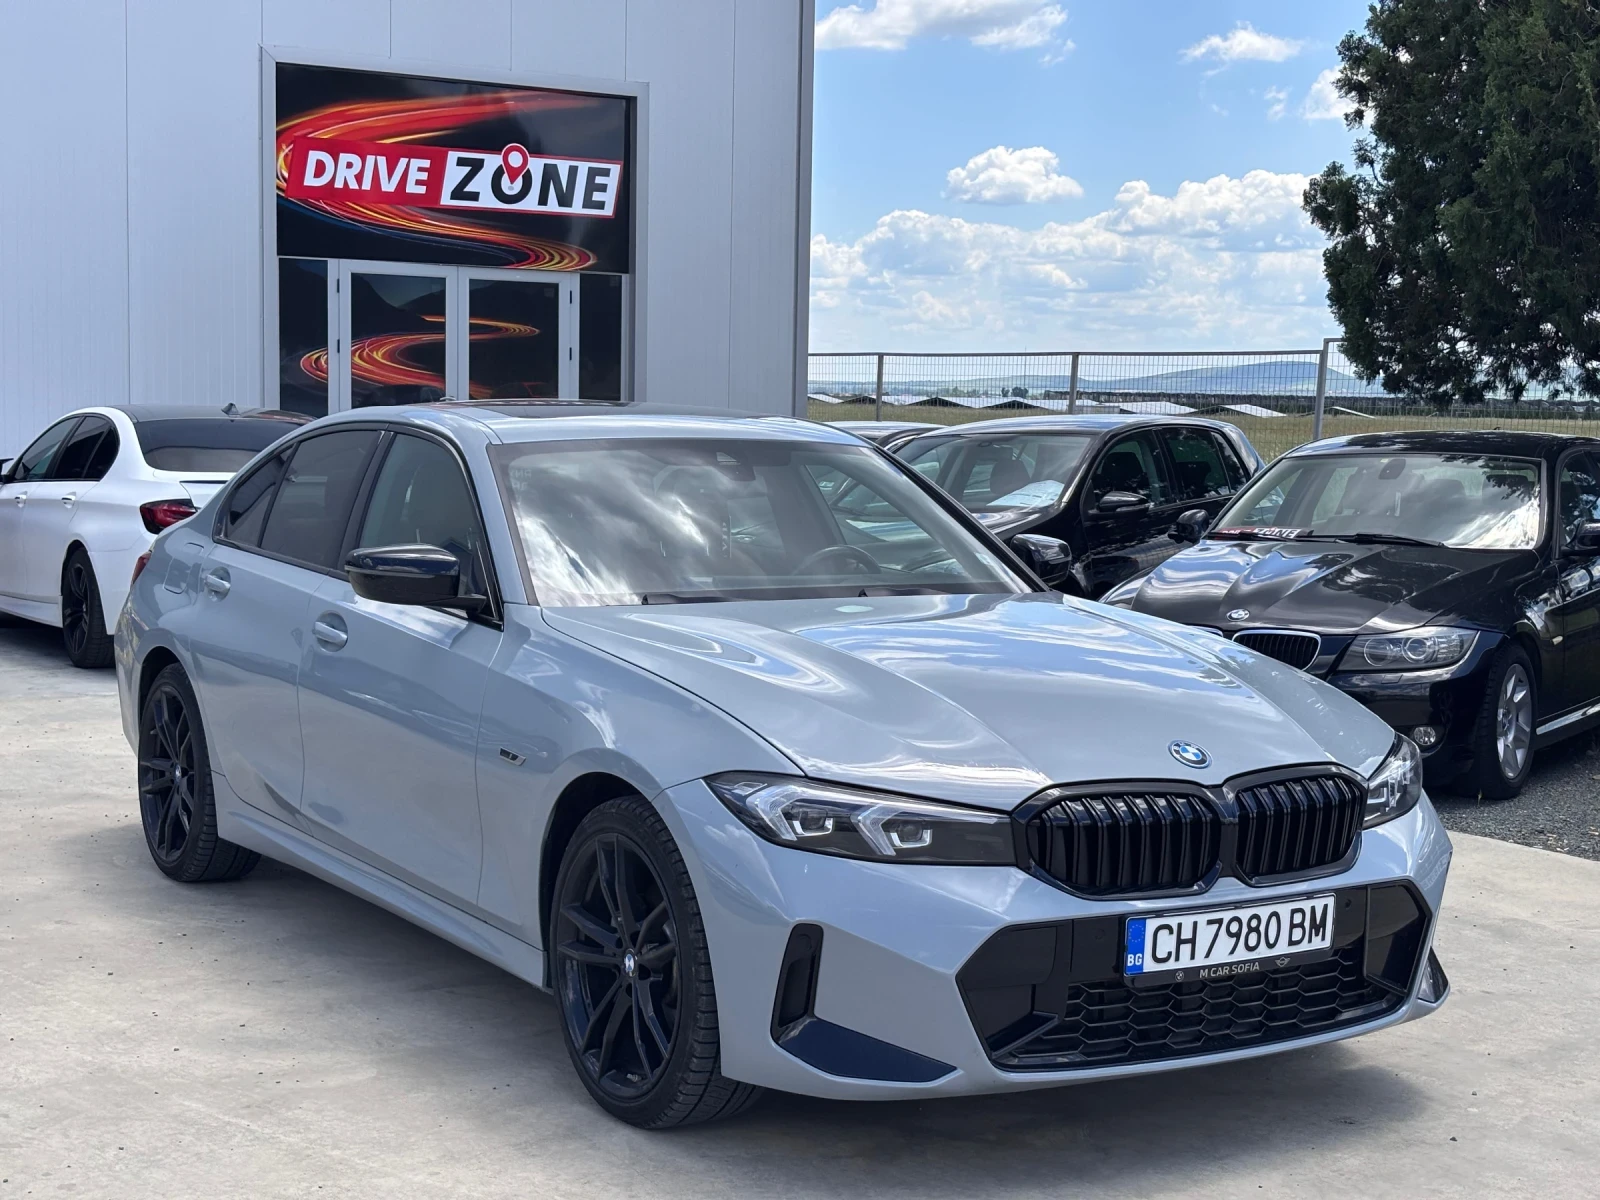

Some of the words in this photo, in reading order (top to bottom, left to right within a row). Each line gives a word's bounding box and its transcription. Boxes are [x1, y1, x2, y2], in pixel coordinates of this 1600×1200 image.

[303, 150, 431, 194] DRIVE
[450, 156, 612, 211] ZONE
[1127, 953, 1143, 967] BG
[1200, 969, 1208, 979] M
[1210, 965, 1230, 977] CAR
[1231, 961, 1260, 975] SOFIA
